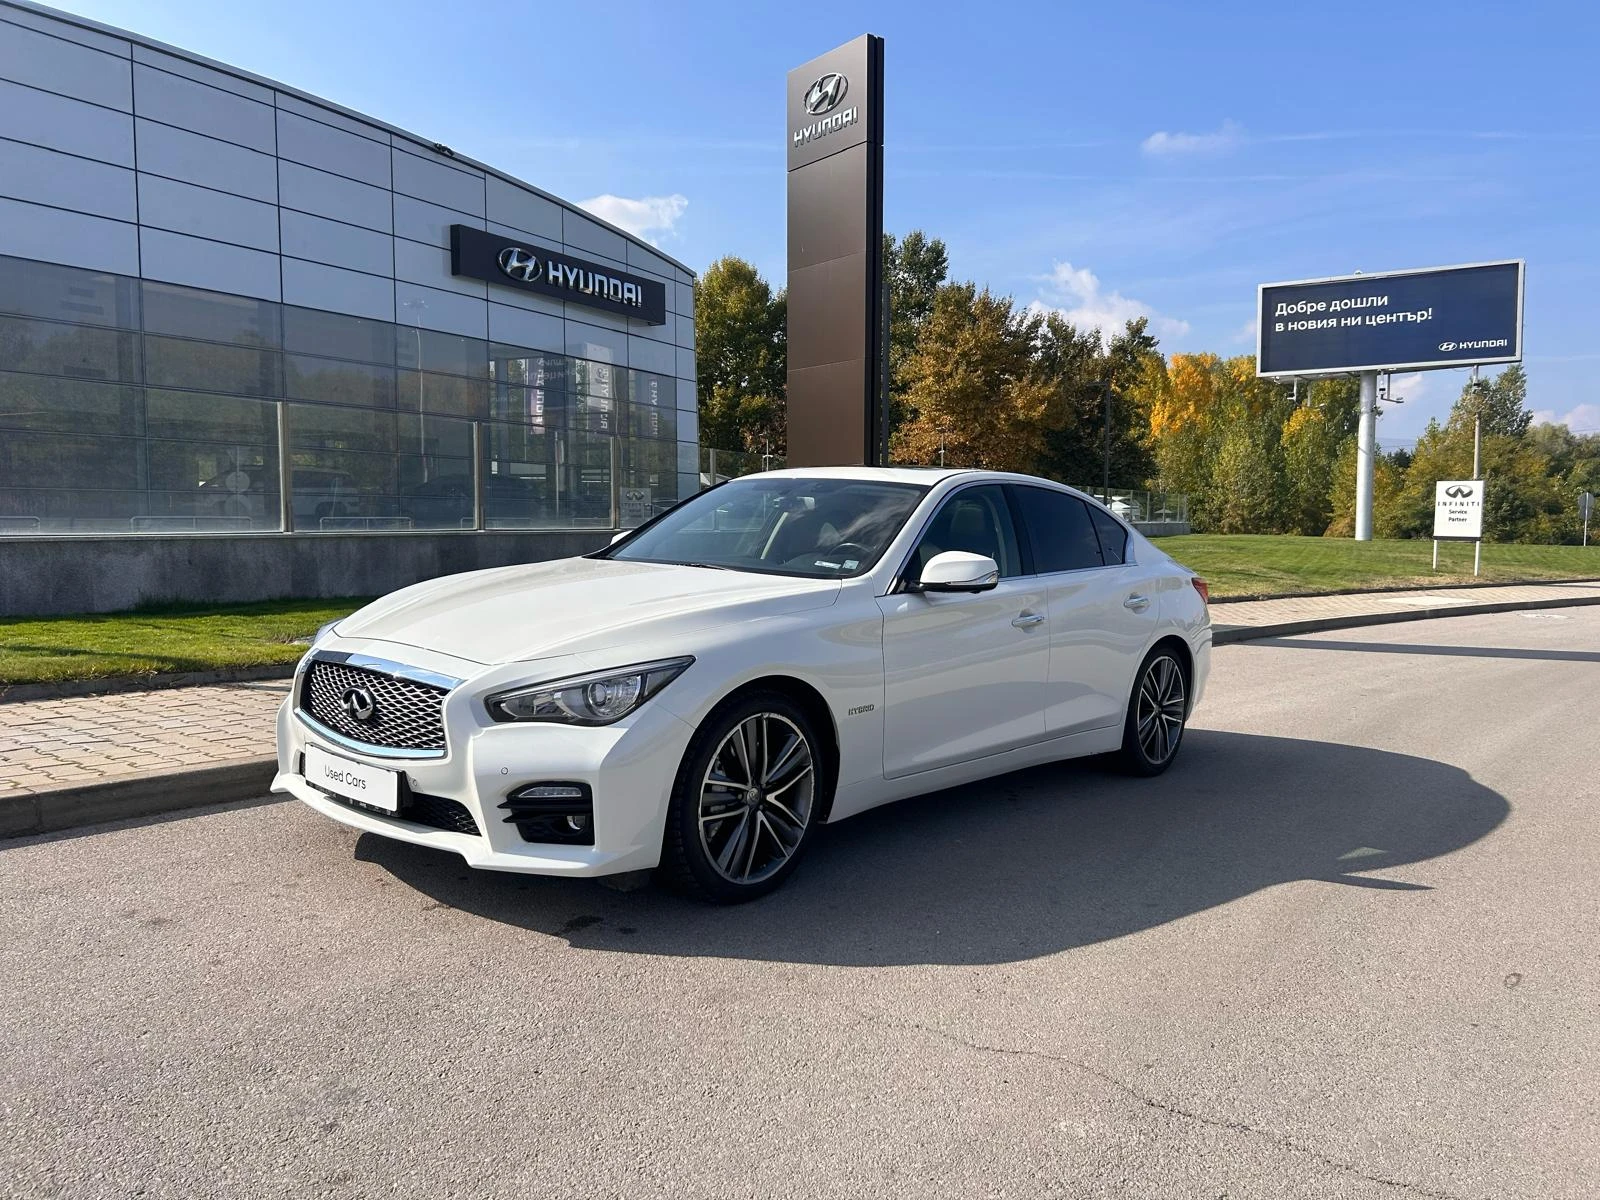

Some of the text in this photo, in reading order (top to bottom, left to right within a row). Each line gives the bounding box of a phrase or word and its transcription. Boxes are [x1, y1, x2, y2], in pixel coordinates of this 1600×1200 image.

[793, 106, 858, 147] HYUNDAI
[548, 261, 642, 307] HYUNDAI
[1275, 295, 1388, 317] Добре дошли
[1275, 307, 1433, 332] в новия ни център!
[1459, 339, 1508, 349] HYUNDAI
[848, 704, 874, 716] HYBRID
[324, 764, 367, 790] Used Cars
